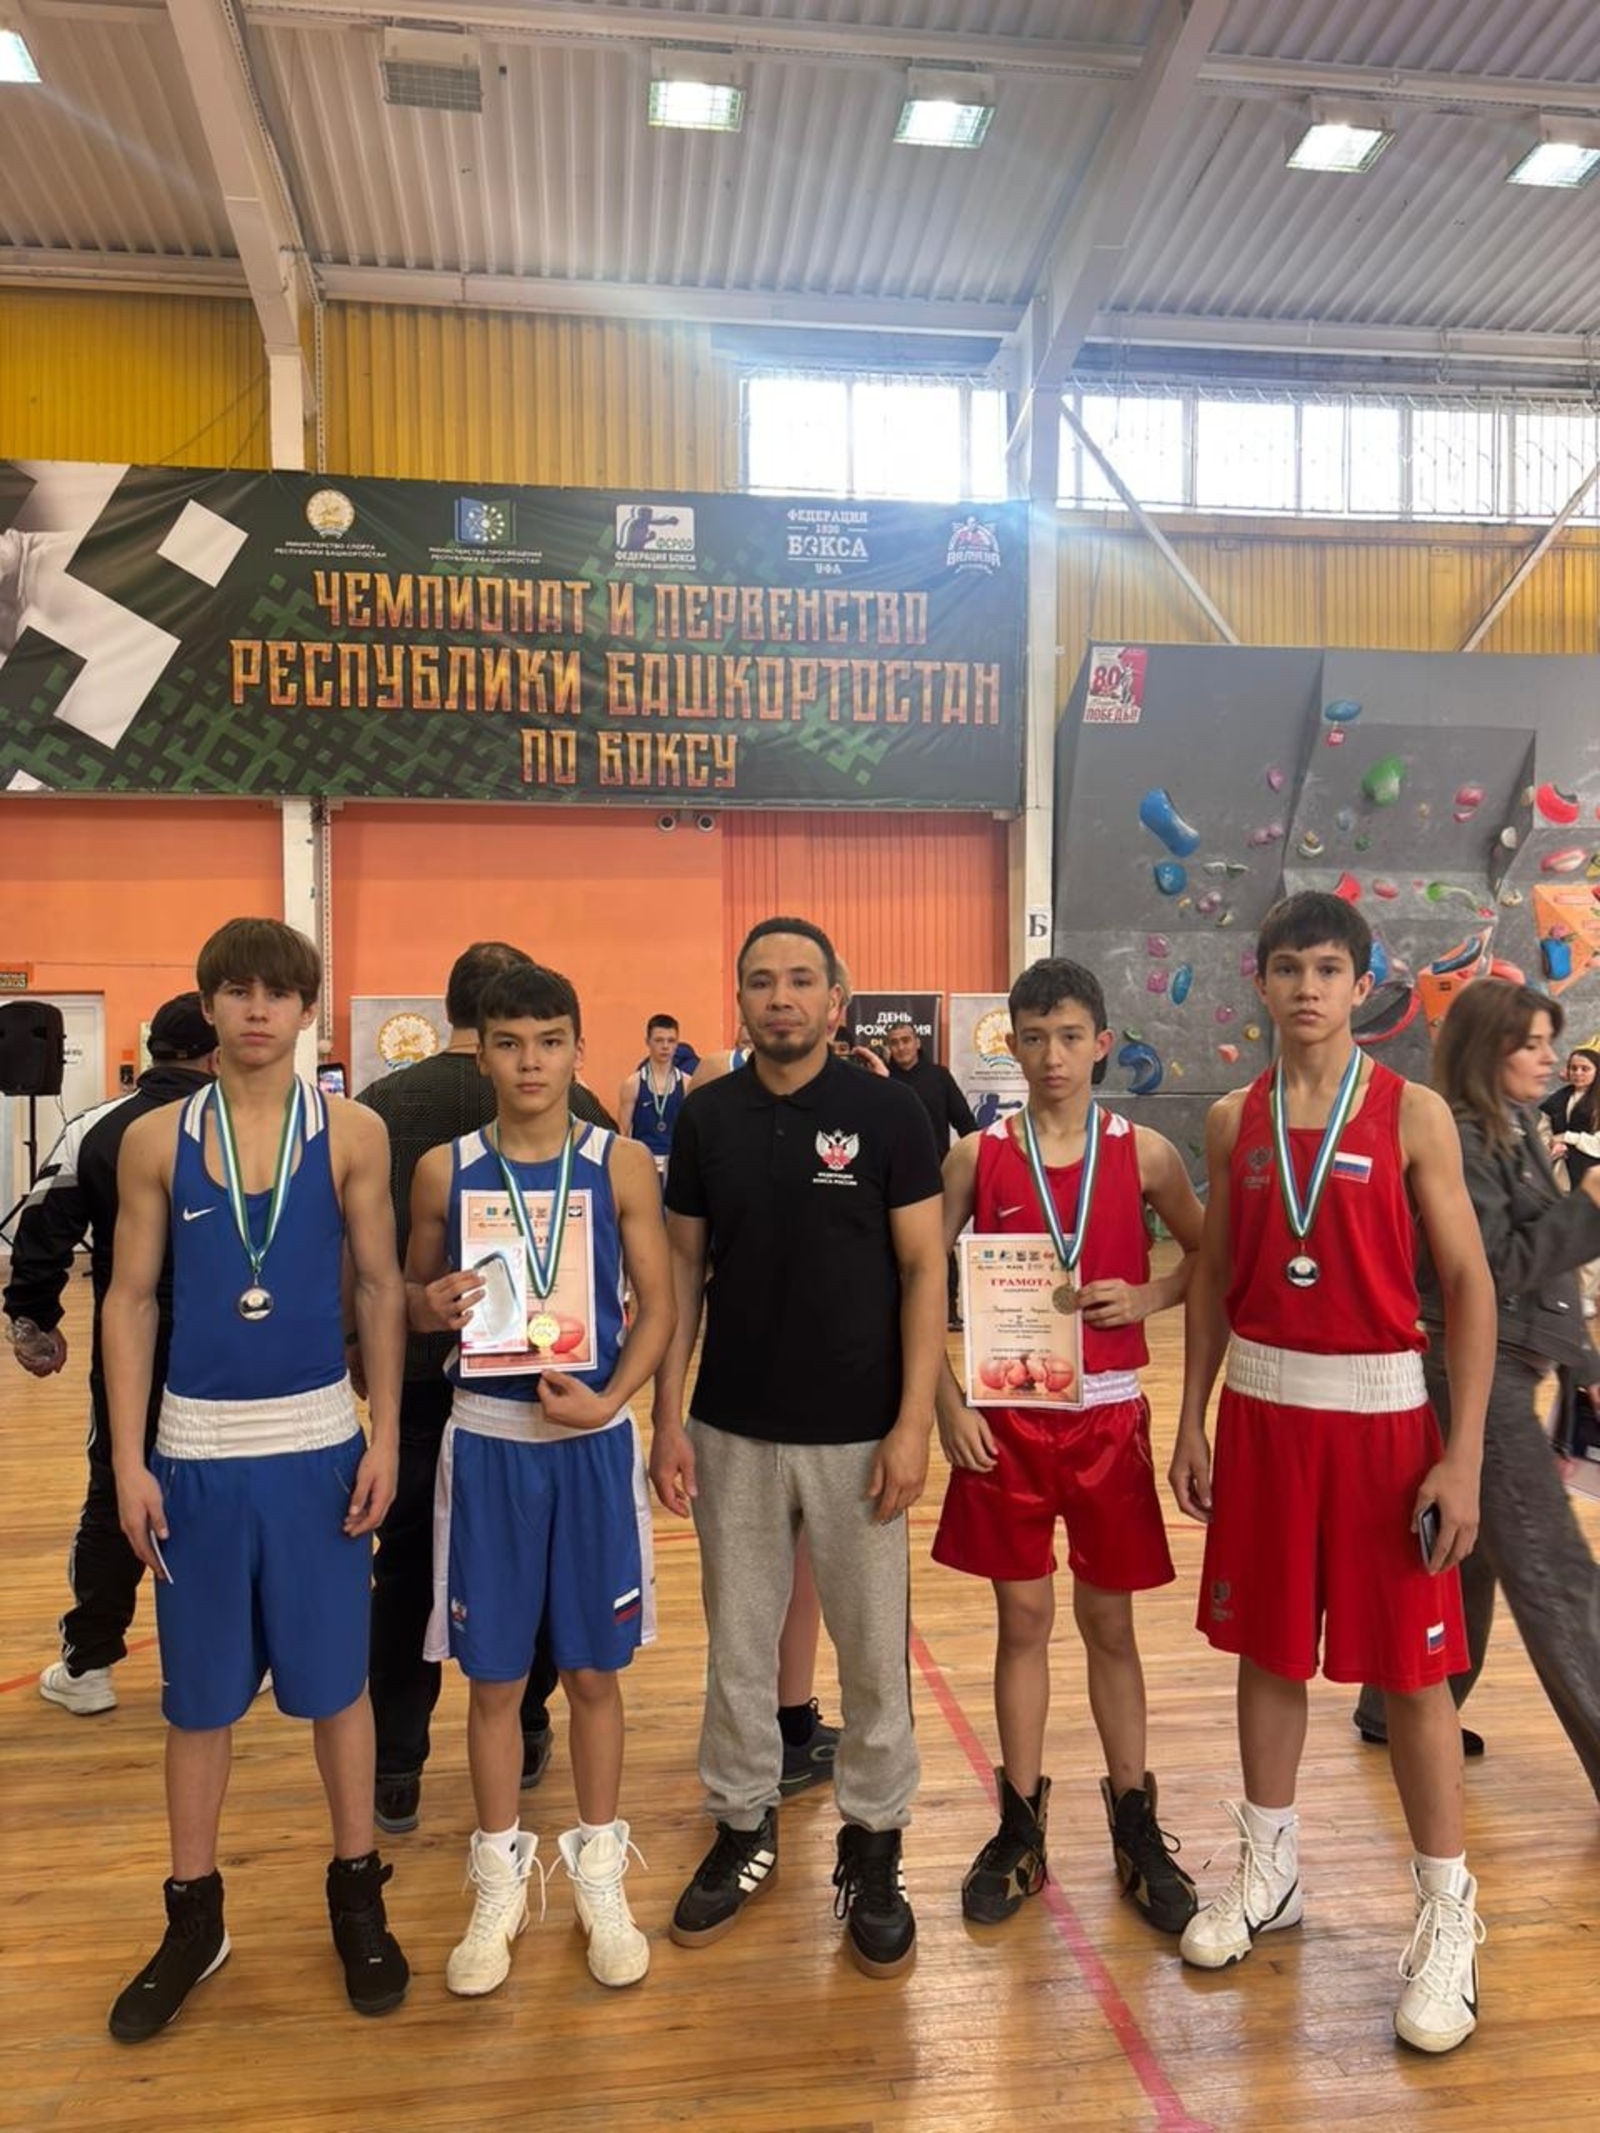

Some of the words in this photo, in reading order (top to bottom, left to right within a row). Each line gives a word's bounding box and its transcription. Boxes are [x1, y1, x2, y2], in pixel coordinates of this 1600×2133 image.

[787, 508, 868, 524] ФЕДЕРАЦИЯ
[615, 550, 668, 562] ФЕДЕРАЦИЯ
[787, 534, 868, 557] БОКСА
[313, 570, 592, 634] ЧЕМПИОНАТ
[608, 581, 636, 638] И
[655, 583, 930, 646] ПЕРВЕНСТВО
[230, 639, 583, 716] РЕСПУБЛИКИ
[605, 651, 1001, 726] БАШКОРТОСТАН
[1091, 665, 1121, 694] 80
[520, 728, 578, 785] ПО
[598, 730, 740, 788] БОКСУ
[1029, 914, 1048, 938] Б
[855, 1024, 931, 1035] РОЖИЯ
[876, 1012, 912, 1024] ДЕНЬ
[990, 1278, 1053, 1287] ГРАМОТА
